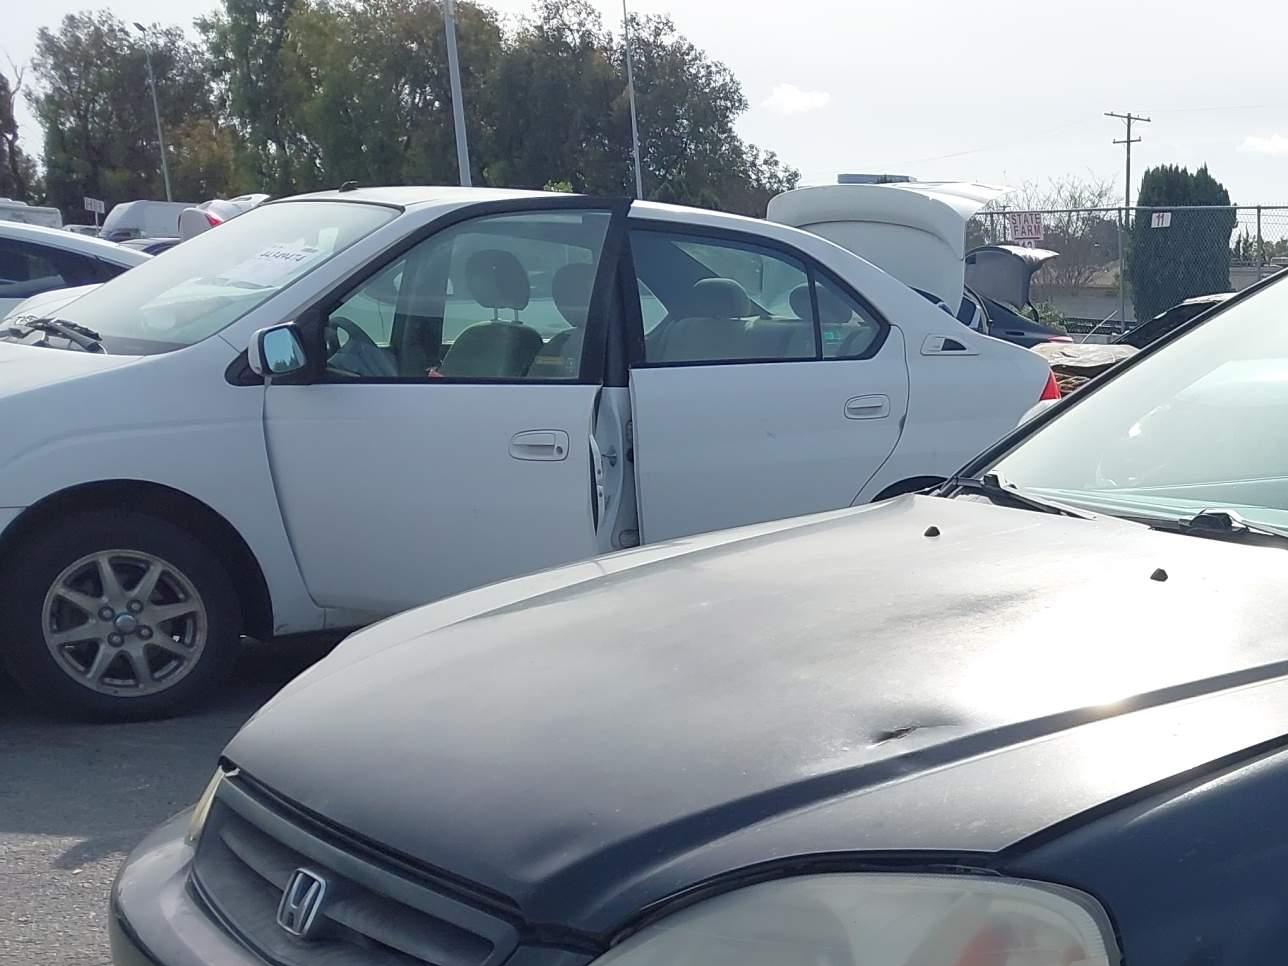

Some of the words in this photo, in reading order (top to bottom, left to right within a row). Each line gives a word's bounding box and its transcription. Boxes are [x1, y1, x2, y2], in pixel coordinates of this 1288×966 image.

[1010, 213, 1042, 225] STATE
[1155, 213, 1165, 226] 11
[1013, 224, 1041, 237] FARM
